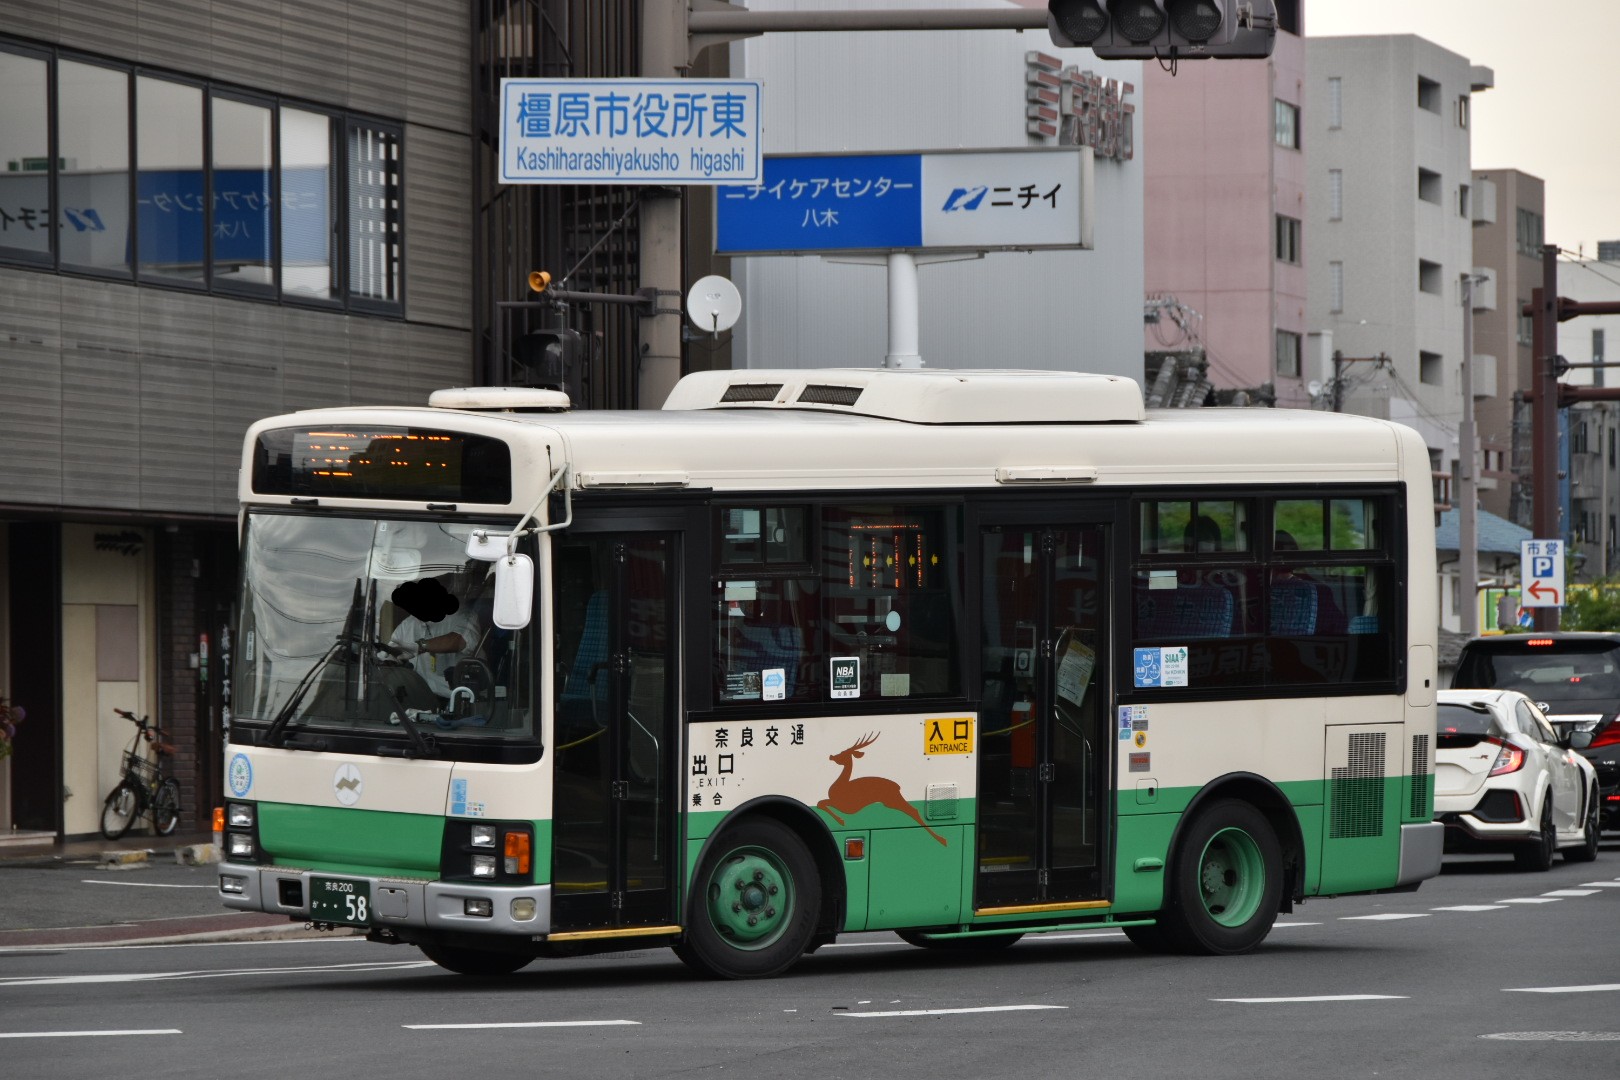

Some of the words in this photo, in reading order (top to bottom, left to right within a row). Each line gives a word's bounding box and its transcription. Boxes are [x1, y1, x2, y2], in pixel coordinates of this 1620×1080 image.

[516, 91, 746, 139] 橿原市役所東
[517, 146, 680, 176] Kashiharashiyakusho
[690, 147, 744, 176] higashi
[991, 183, 1061, 209] ニチイ
[802, 208, 838, 228] 八木
[1528, 542, 1558, 555] 市営
[1536, 558, 1551, 576] P
[836, 666, 854, 676] NBA
[715, 724, 804, 748] 奈良交通
[929, 720, 969, 742] 入口
[929, 743, 968, 753] ENTRANCE
[692, 753, 734, 776] 出口
[699, 777, 726, 787] EXIT
[692, 792, 723, 807] 乗合
[346, 894, 367, 921] 58
